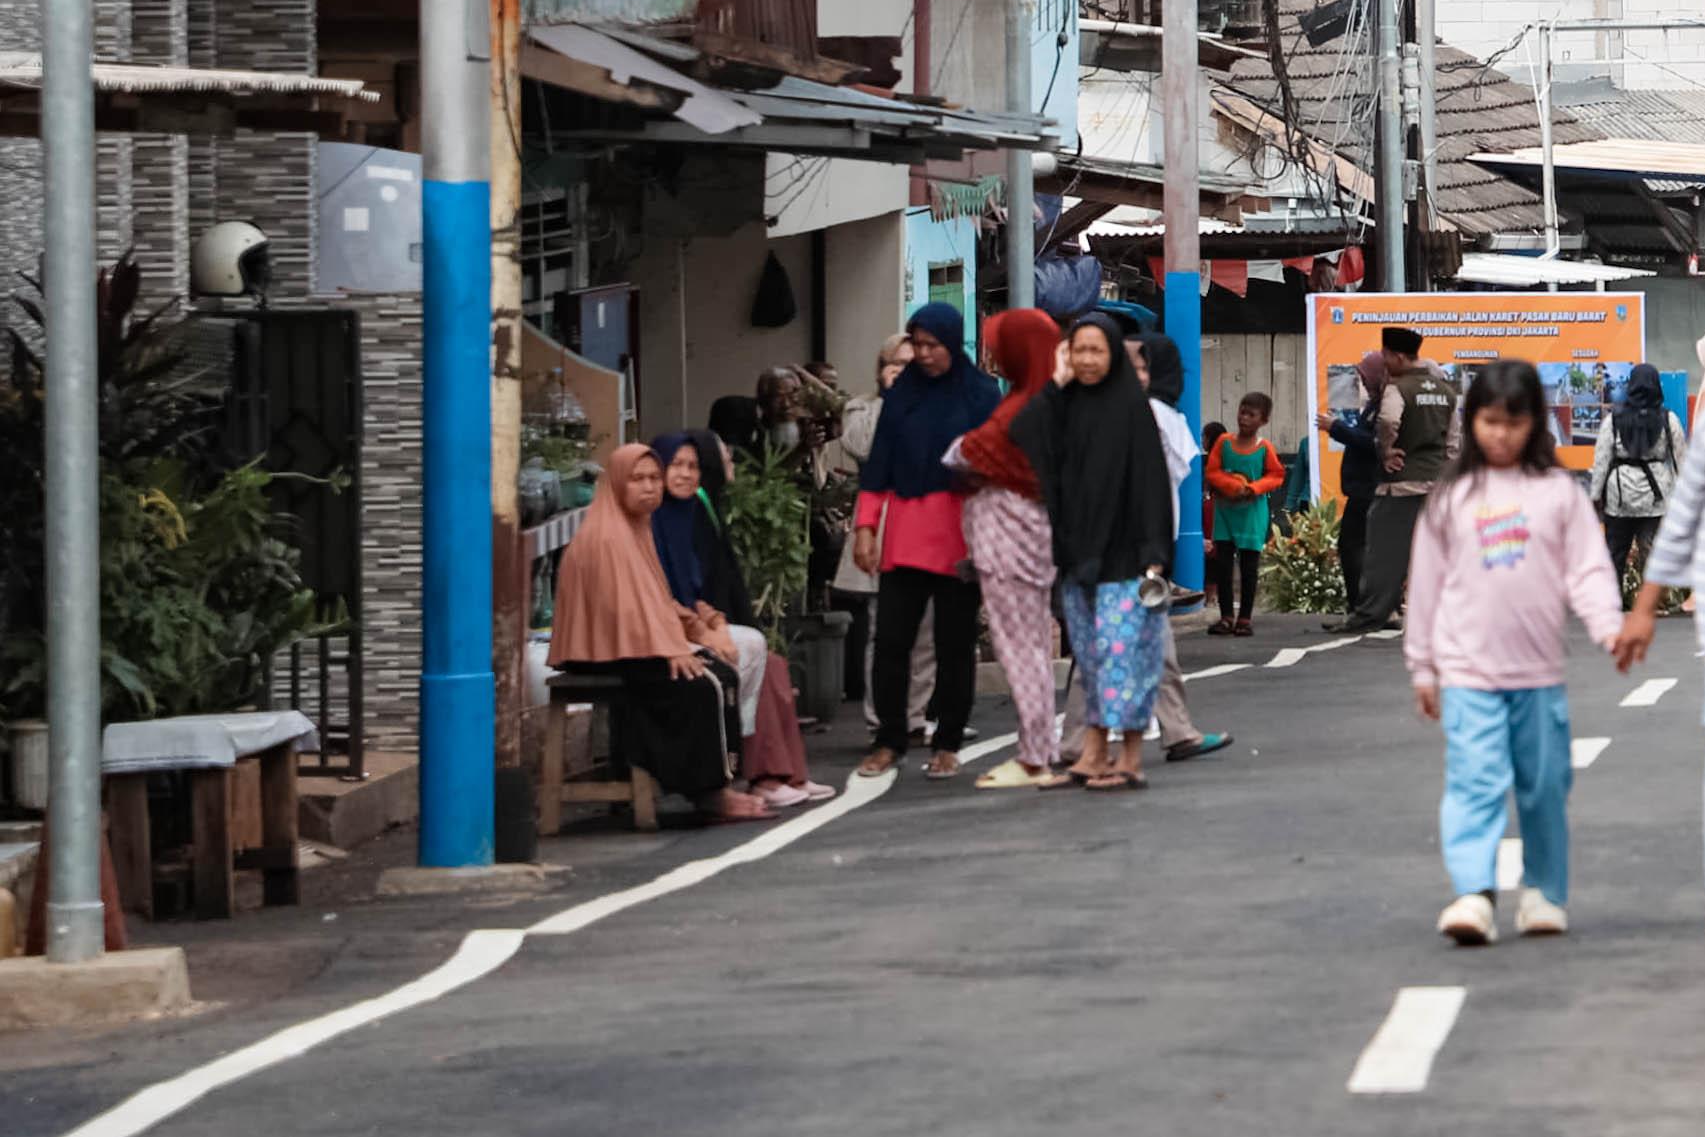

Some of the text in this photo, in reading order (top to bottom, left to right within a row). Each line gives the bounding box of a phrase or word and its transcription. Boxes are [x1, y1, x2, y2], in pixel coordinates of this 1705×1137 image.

[1352, 311, 1606, 323] PENINJAUAN PERBAIKAN JALAN KARET PASAR BARU BARAT
[1423, 327, 1465, 337] GUBERNUR
[1466, 327, 1504, 336] PROVINSI
[1521, 327, 1559, 336] JAKARTA
